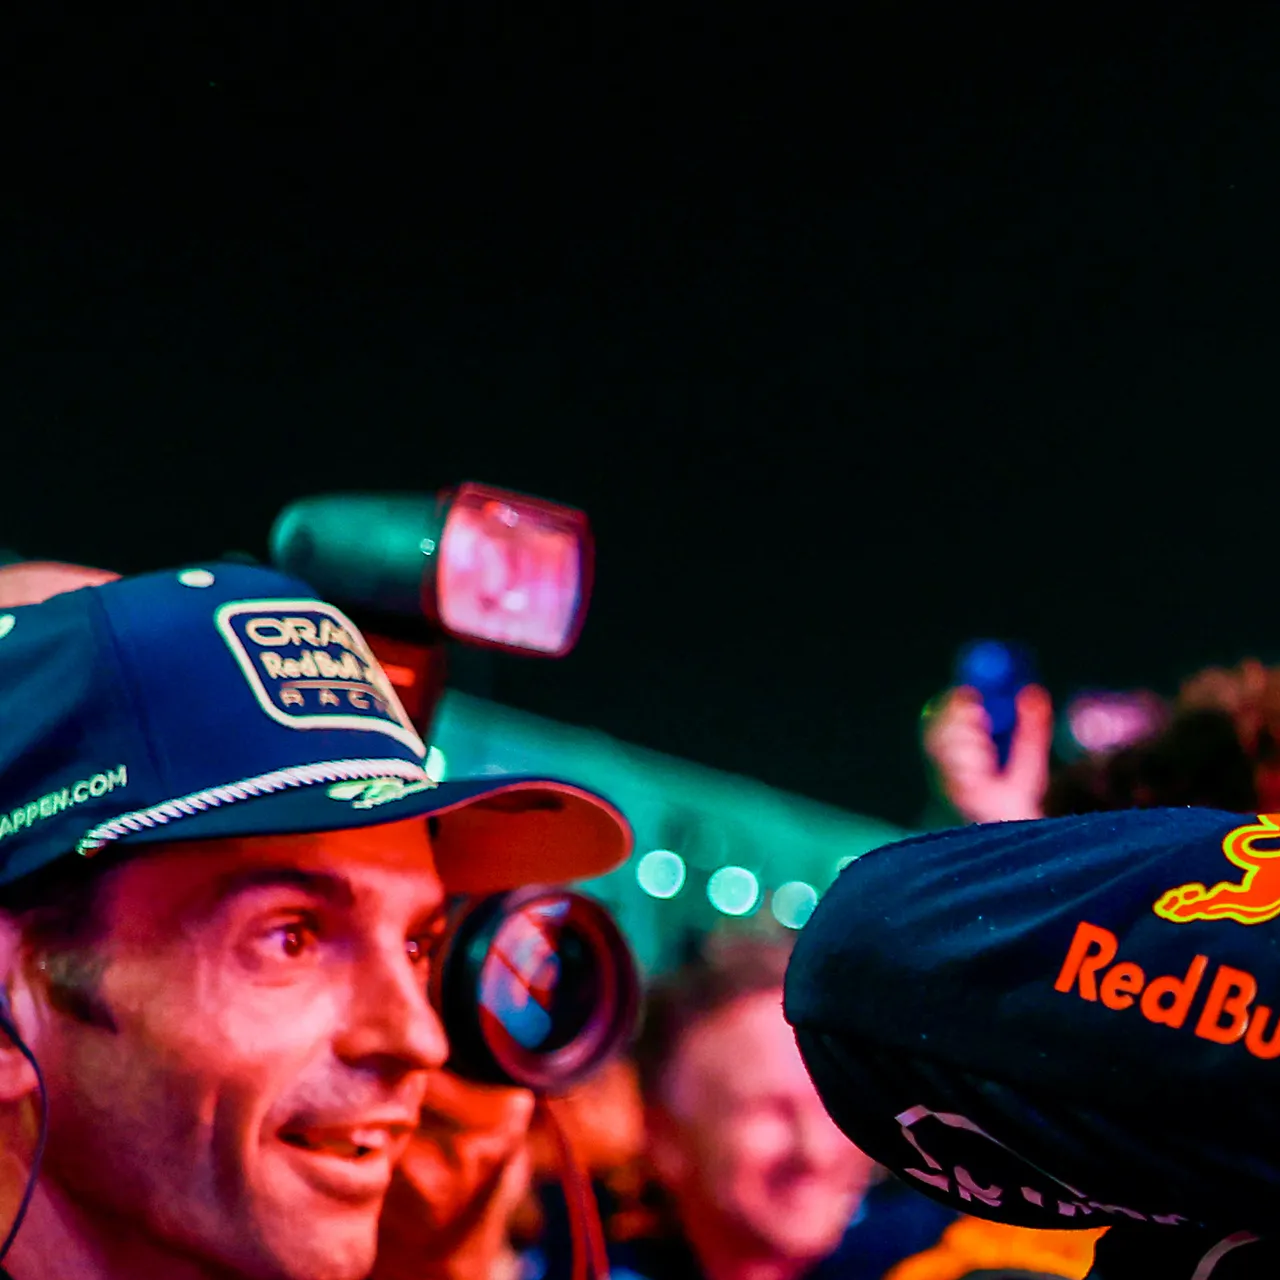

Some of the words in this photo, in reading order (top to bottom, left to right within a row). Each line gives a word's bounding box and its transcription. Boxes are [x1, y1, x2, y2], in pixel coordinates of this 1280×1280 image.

[245, 617, 362, 647] ORA
[0, 764, 128, 838] APPEN.COM
[1054, 921, 1208, 1030] Red
